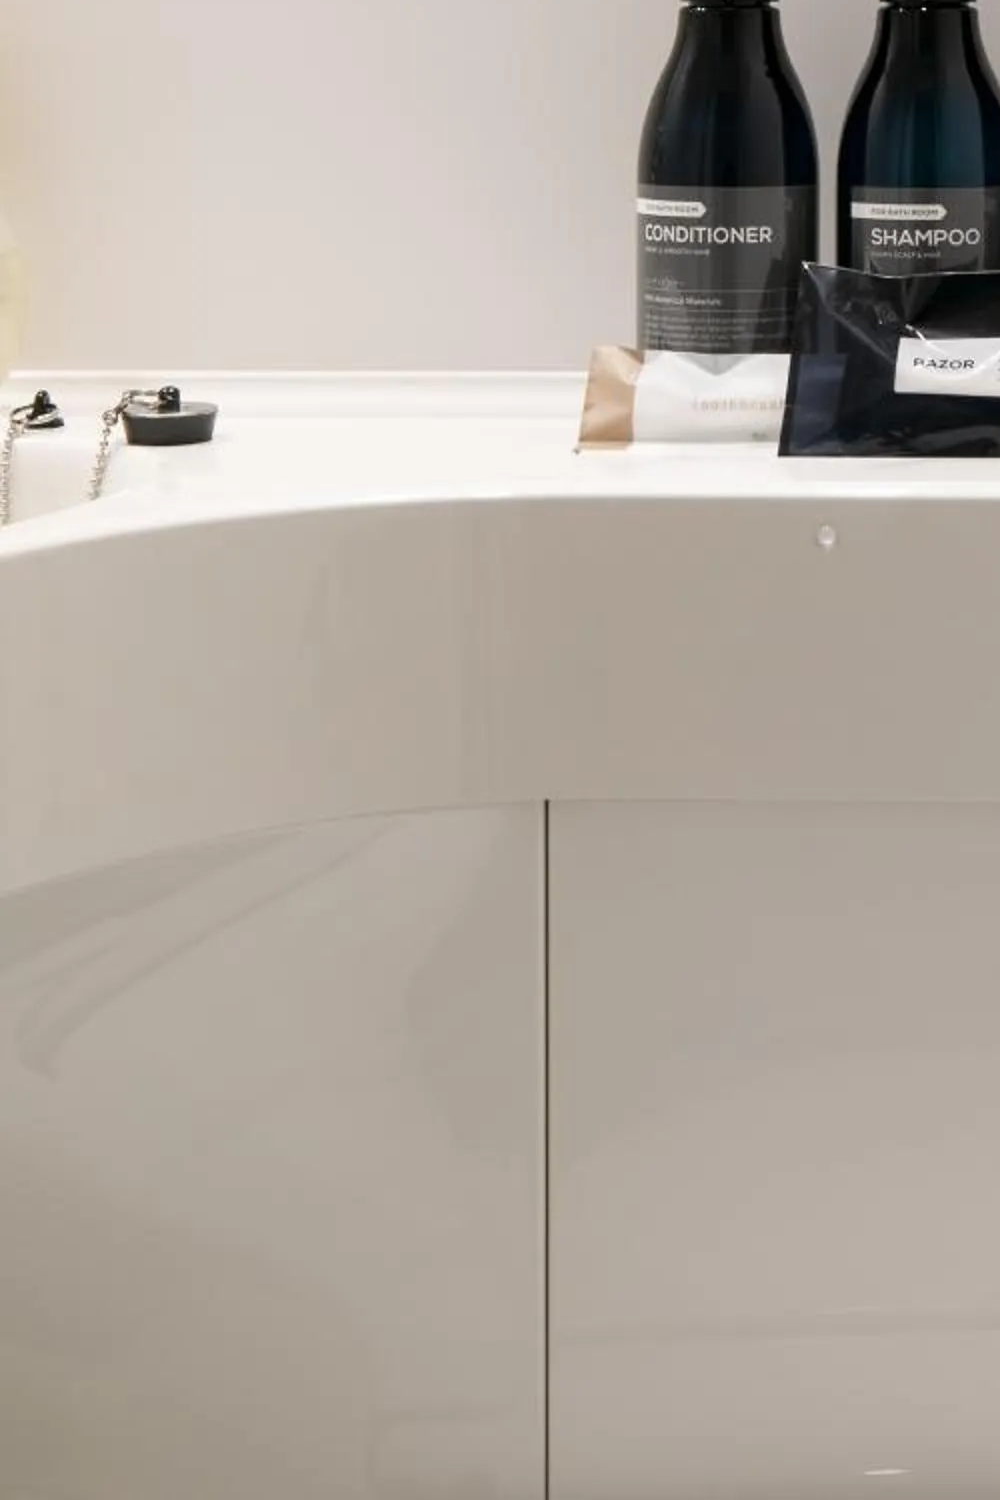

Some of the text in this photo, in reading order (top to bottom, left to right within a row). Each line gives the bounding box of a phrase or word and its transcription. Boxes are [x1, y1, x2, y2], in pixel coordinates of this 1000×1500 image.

[645, 223, 773, 244] CONDITIONER
[871, 227, 981, 246] SHAMPOO
[913, 357, 975, 370] RAZOR
